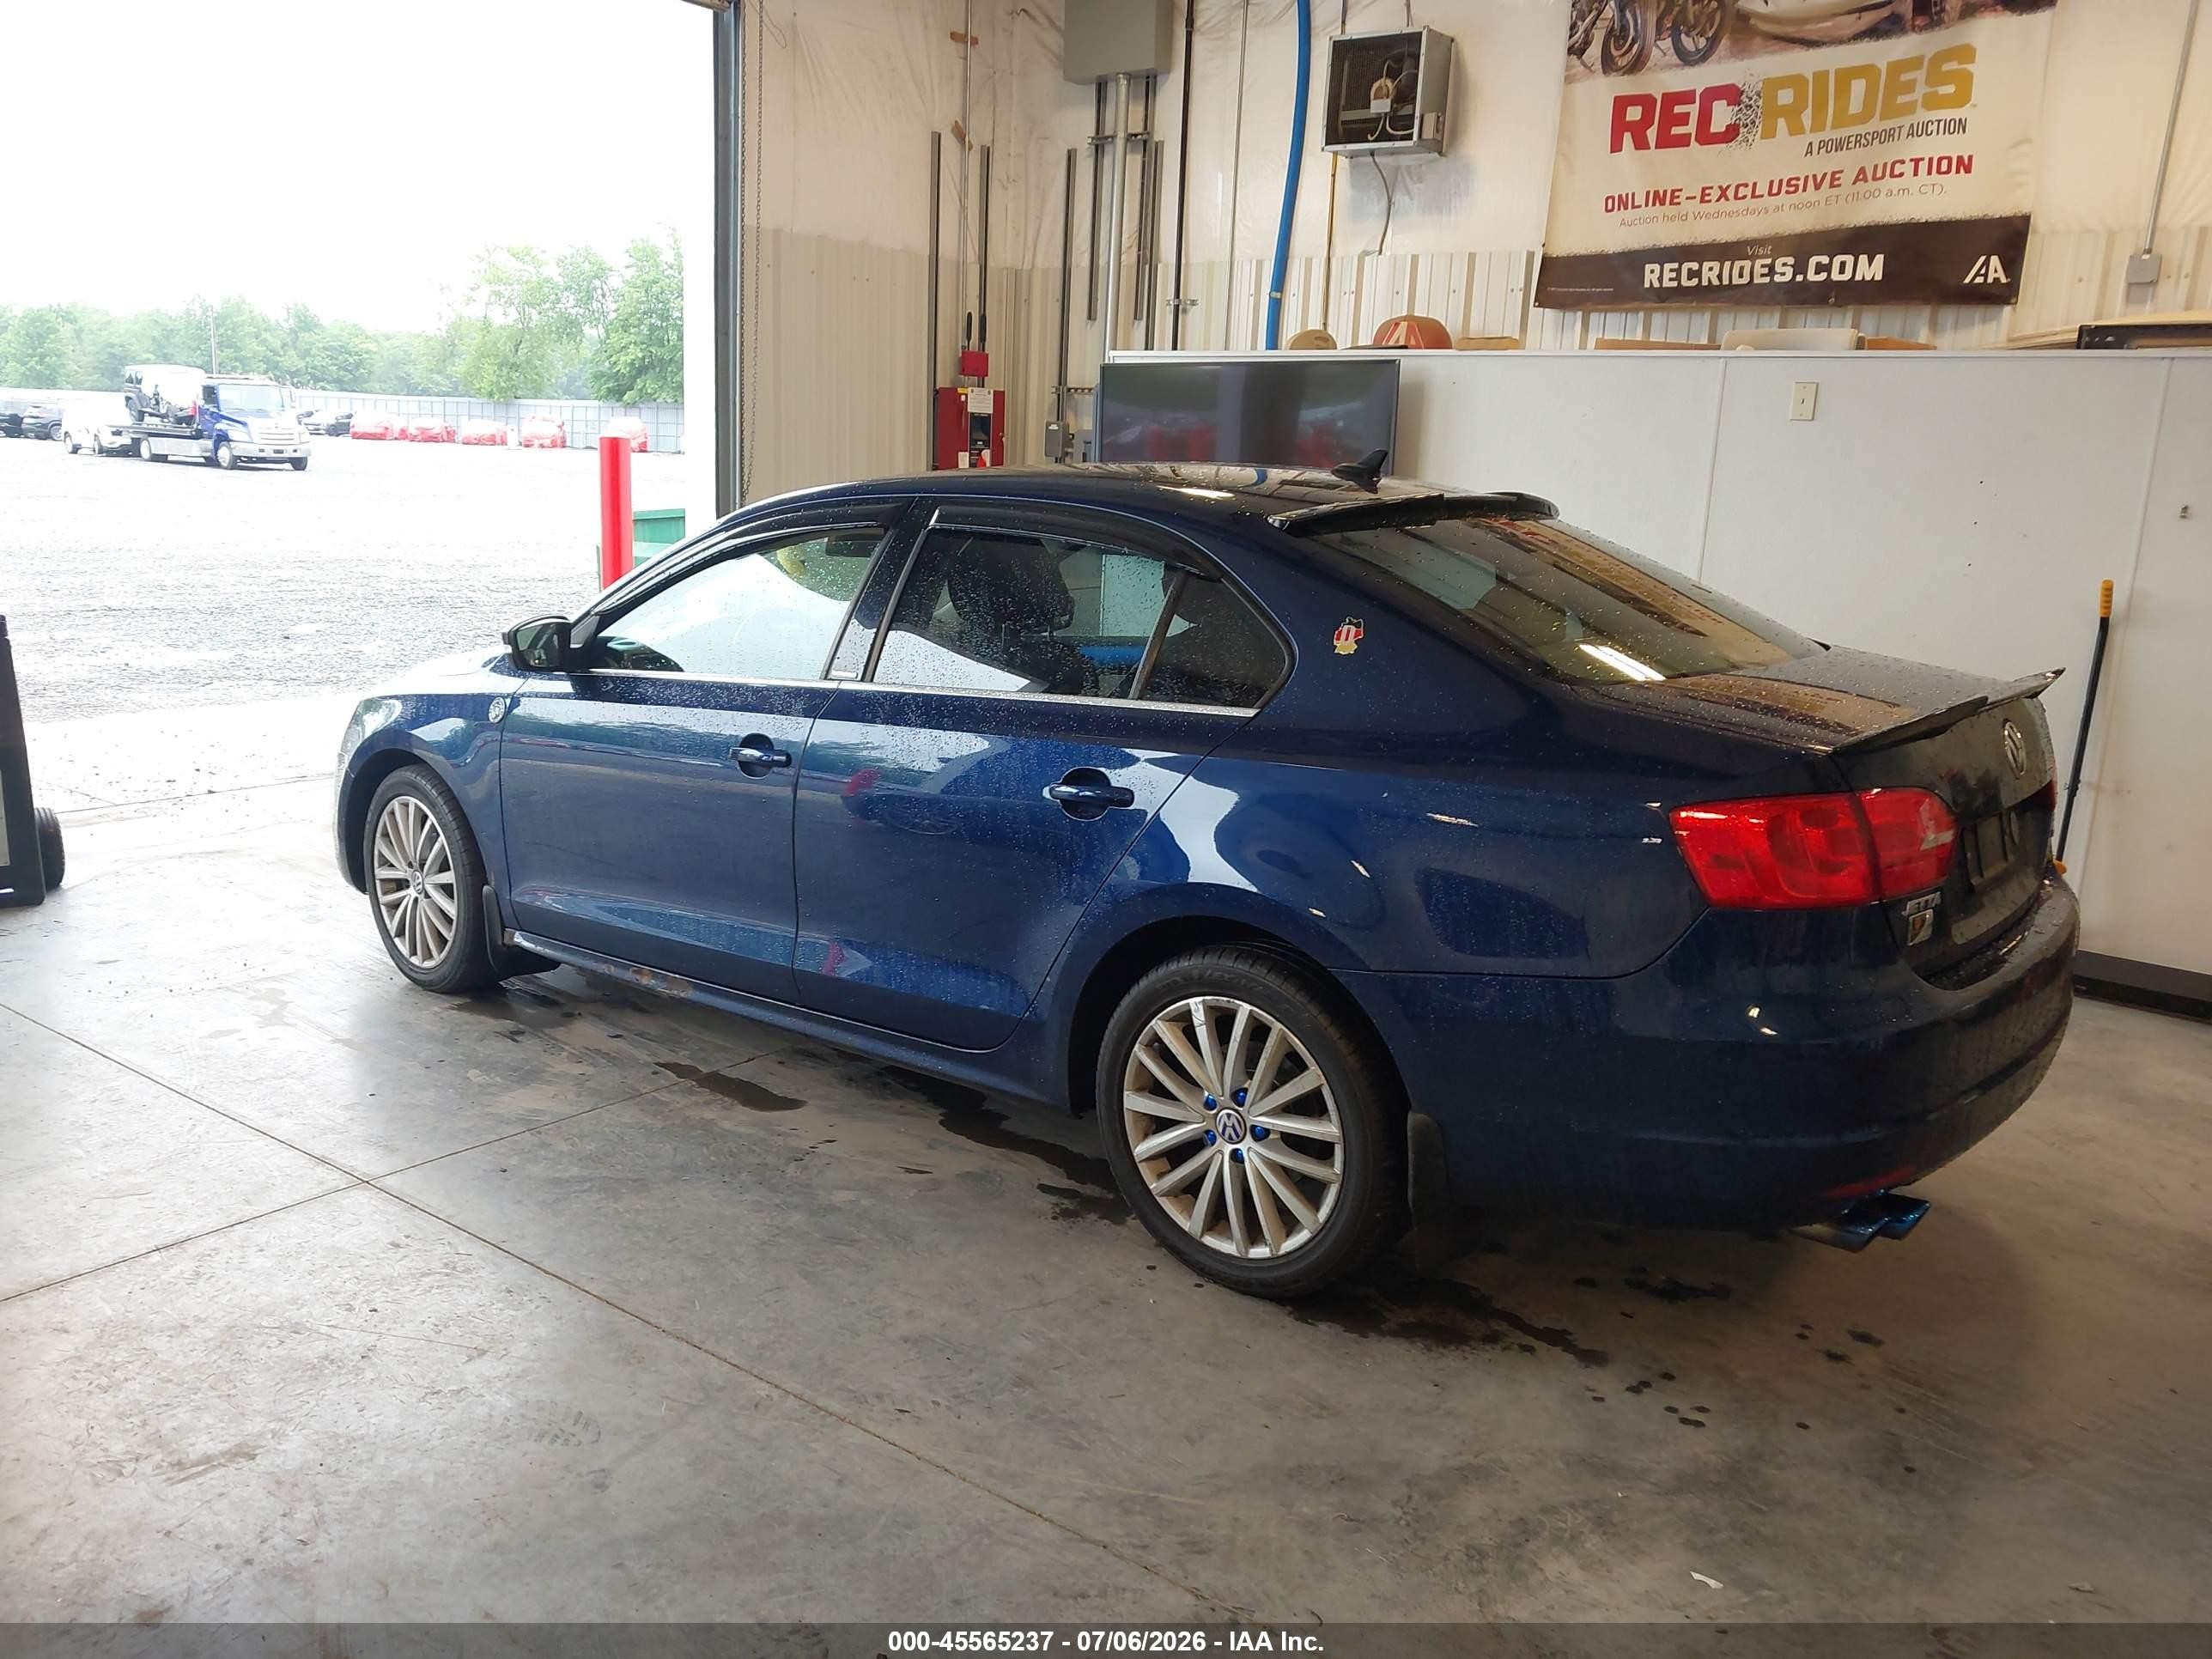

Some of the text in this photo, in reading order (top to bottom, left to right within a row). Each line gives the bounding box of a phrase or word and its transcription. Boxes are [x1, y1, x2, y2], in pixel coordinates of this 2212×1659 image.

[1610, 43, 1977, 153] REC RIDES
[1804, 118, 1967, 157] A POWERSPORT AUCTION
[1604, 155, 1973, 213] ONLINE-EXCLUSIVE AUCTION
[1620, 214, 1658, 228] Auction
[1662, 210, 1688, 223] held
[1692, 205, 1769, 222] Wednesdays
[1773, 204, 1785, 212] at
[1789, 199, 1820, 211] noon
[1825, 195, 1841, 206] ET
[1885, 186, 1913, 198] a.m.
[1747, 244, 1772, 256] Visit
[1644, 254, 1885, 289] RECRIDES.COM
